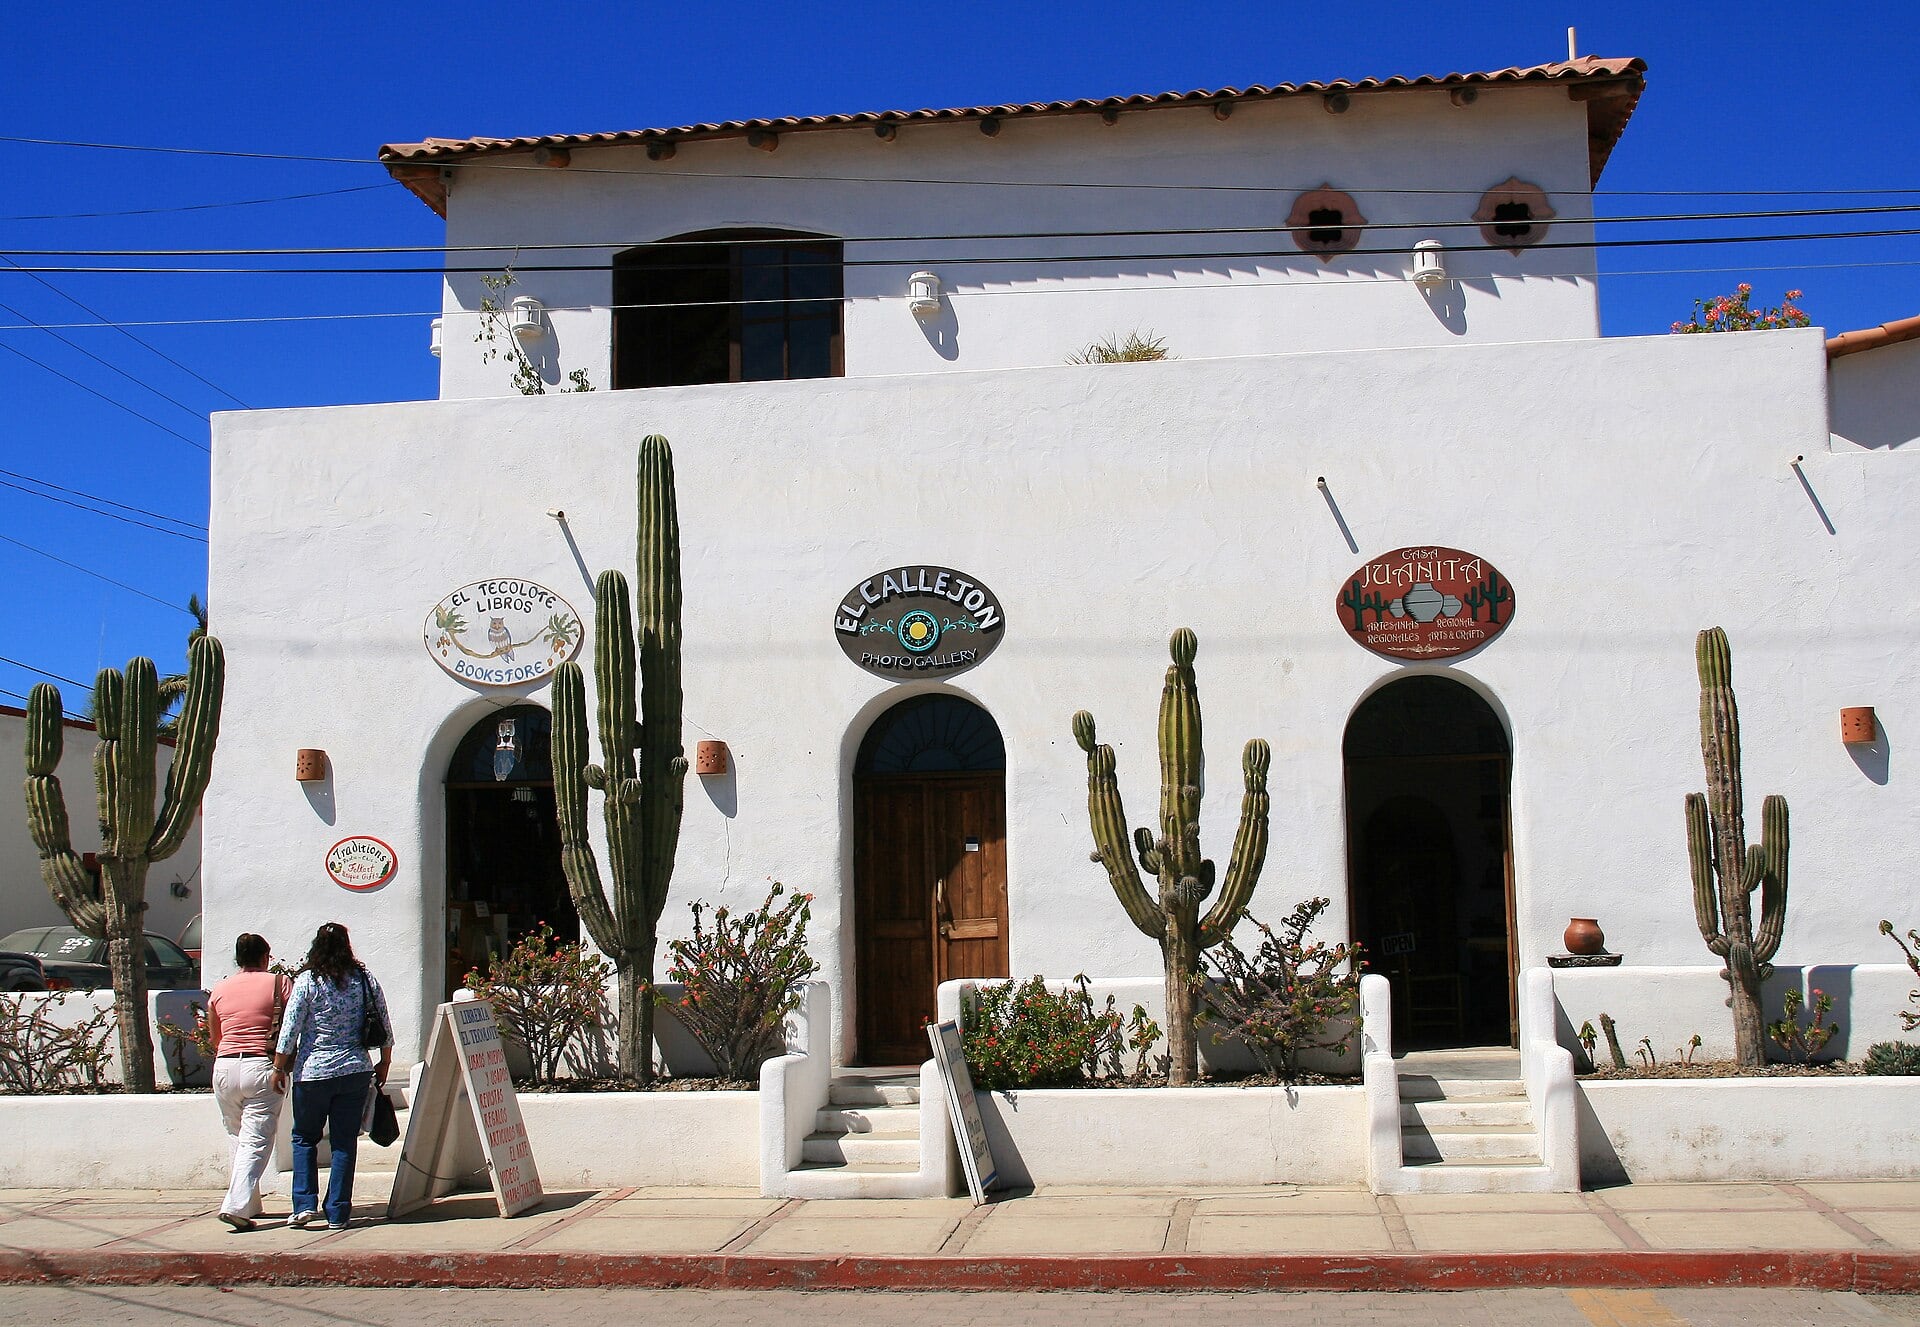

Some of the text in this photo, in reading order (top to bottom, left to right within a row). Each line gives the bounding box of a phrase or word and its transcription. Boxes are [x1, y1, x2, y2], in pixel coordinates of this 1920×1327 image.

[1401, 549, 1438, 560] CASA
[1362, 558, 1482, 588] JUANITA
[452, 581, 557, 609] EL TECOLOTE
[835, 568, 1000, 632] EL CALLEJON
[477, 597, 532, 613] LIBROS
[1366, 621, 1420, 632] ARTESANIAS
[1436, 618, 1475, 628] REGIONAL
[1367, 633, 1420, 644] REGIONALES
[1427, 629, 1485, 641] ARTS & CRAFTS
[861, 648, 977, 667] PHOTO GALLERY
[455, 660, 544, 682] BOOKSTORE
[332, 840, 387, 862] Traditions
[1383, 933, 1413, 953] OPEN
